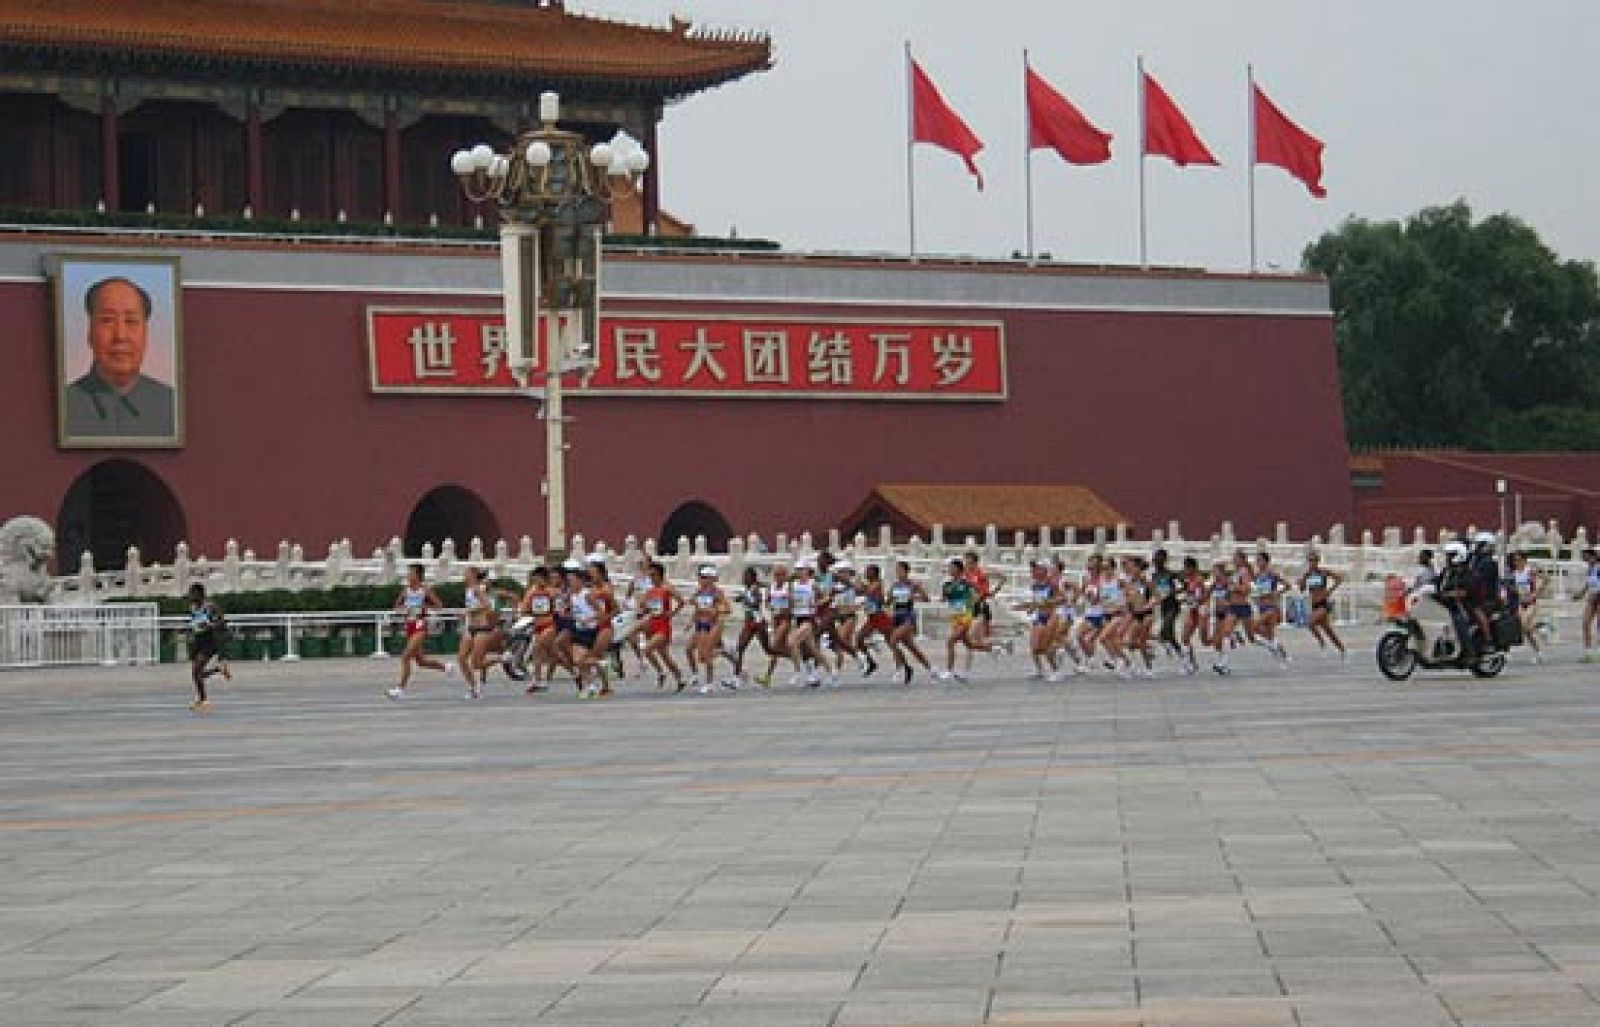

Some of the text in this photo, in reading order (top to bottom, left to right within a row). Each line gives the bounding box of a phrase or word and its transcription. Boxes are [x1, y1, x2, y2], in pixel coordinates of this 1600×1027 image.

[407, 322, 974, 385] 世界民大团结万岁
